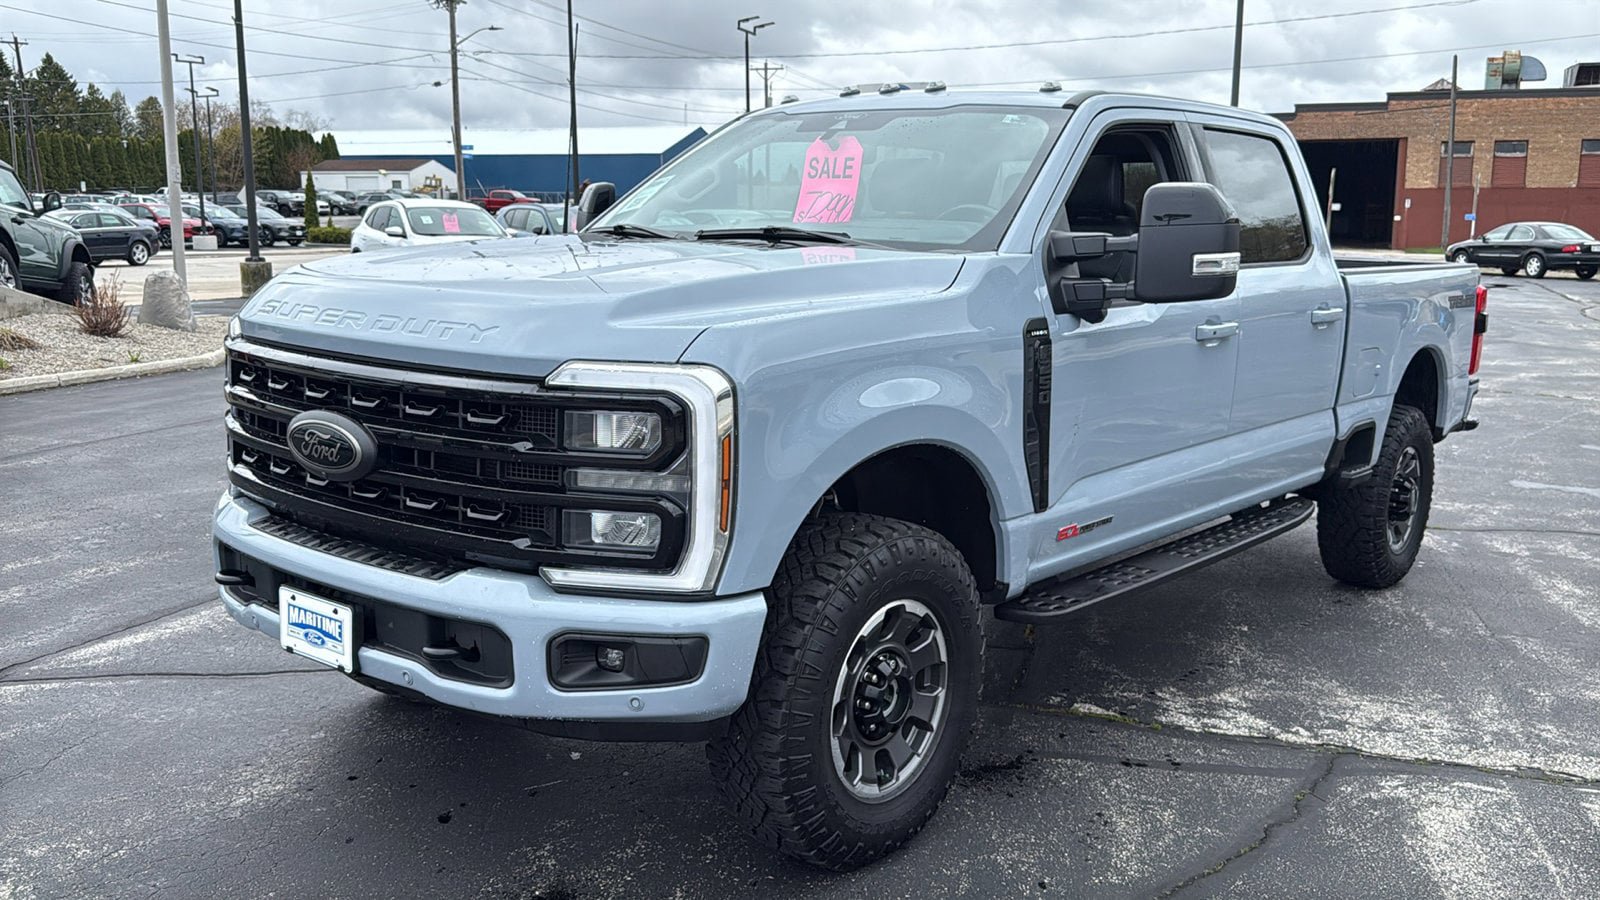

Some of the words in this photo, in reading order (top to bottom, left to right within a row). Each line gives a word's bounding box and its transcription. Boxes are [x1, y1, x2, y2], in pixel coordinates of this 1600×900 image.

[807, 156, 855, 179] SALE
[257, 299, 368, 329] SUPER
[369, 314, 500, 344] DUTY
[301, 429, 341, 462] Ford
[289, 605, 343, 641] MARITIME
